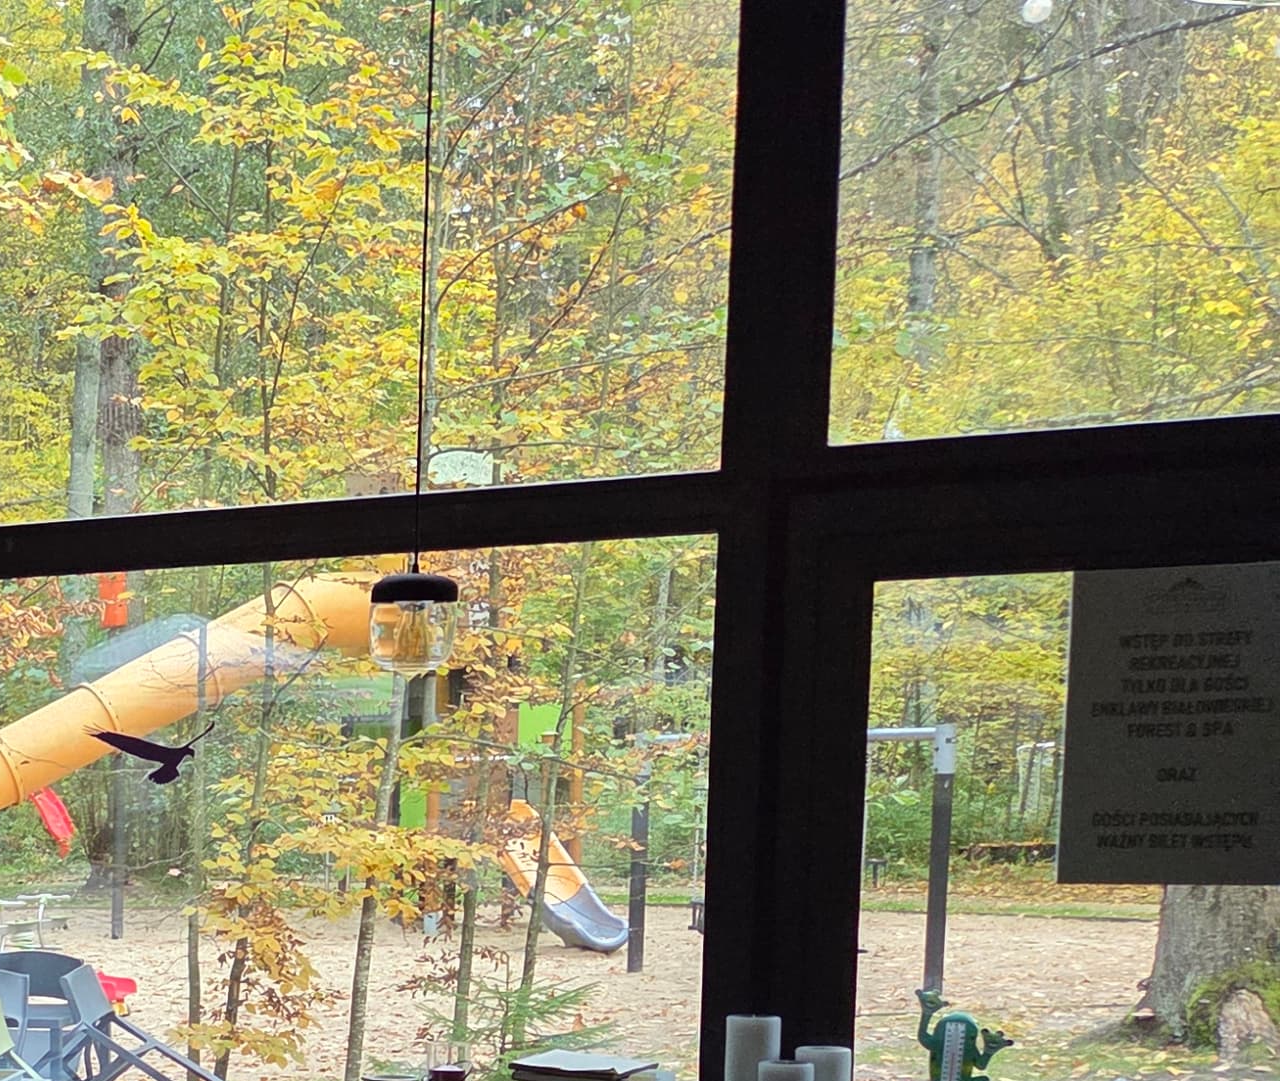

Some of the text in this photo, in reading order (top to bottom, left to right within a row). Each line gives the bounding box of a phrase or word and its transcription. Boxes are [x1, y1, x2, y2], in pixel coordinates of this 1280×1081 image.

[1119, 630, 1253, 650] WSTĘP DO STREFY
[1121, 674, 1249, 693] TYLKO DLA GOŚCI
[1127, 721, 1234, 738] FOREST & SPA
[1156, 767, 1197, 782] ORAZ
[1092, 809, 1135, 827] GOŚCI
[1149, 834, 1187, 848] BILET
